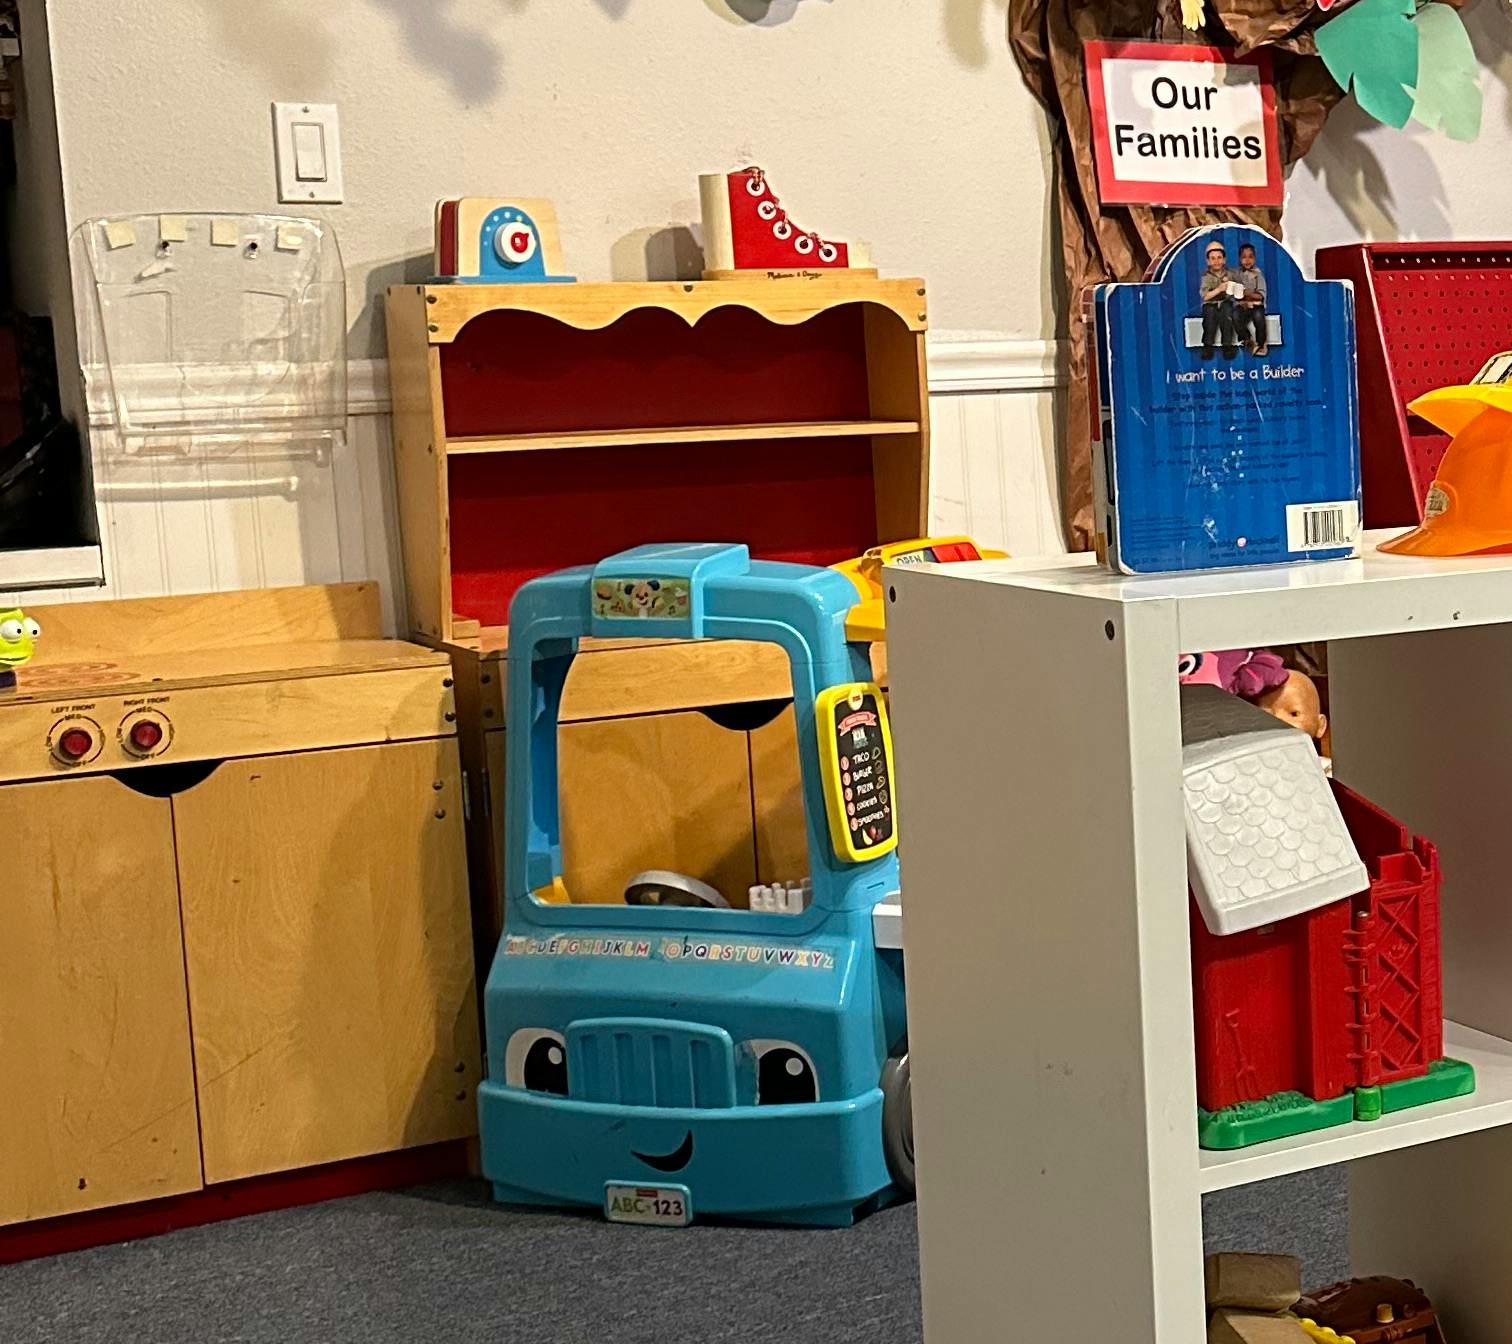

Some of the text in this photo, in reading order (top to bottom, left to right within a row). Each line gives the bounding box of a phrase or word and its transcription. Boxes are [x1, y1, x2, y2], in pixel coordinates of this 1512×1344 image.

[1151, 76, 1218, 111] Our
[1114, 124, 1262, 160] Families
[1166, 364, 1305, 384] I want to be a Builder
[51, 704, 95, 714] LEFT FRONT
[852, 752, 870, 765] TACO
[856, 782, 874, 796] PIZZA
[856, 796, 878, 811] COOKIES
